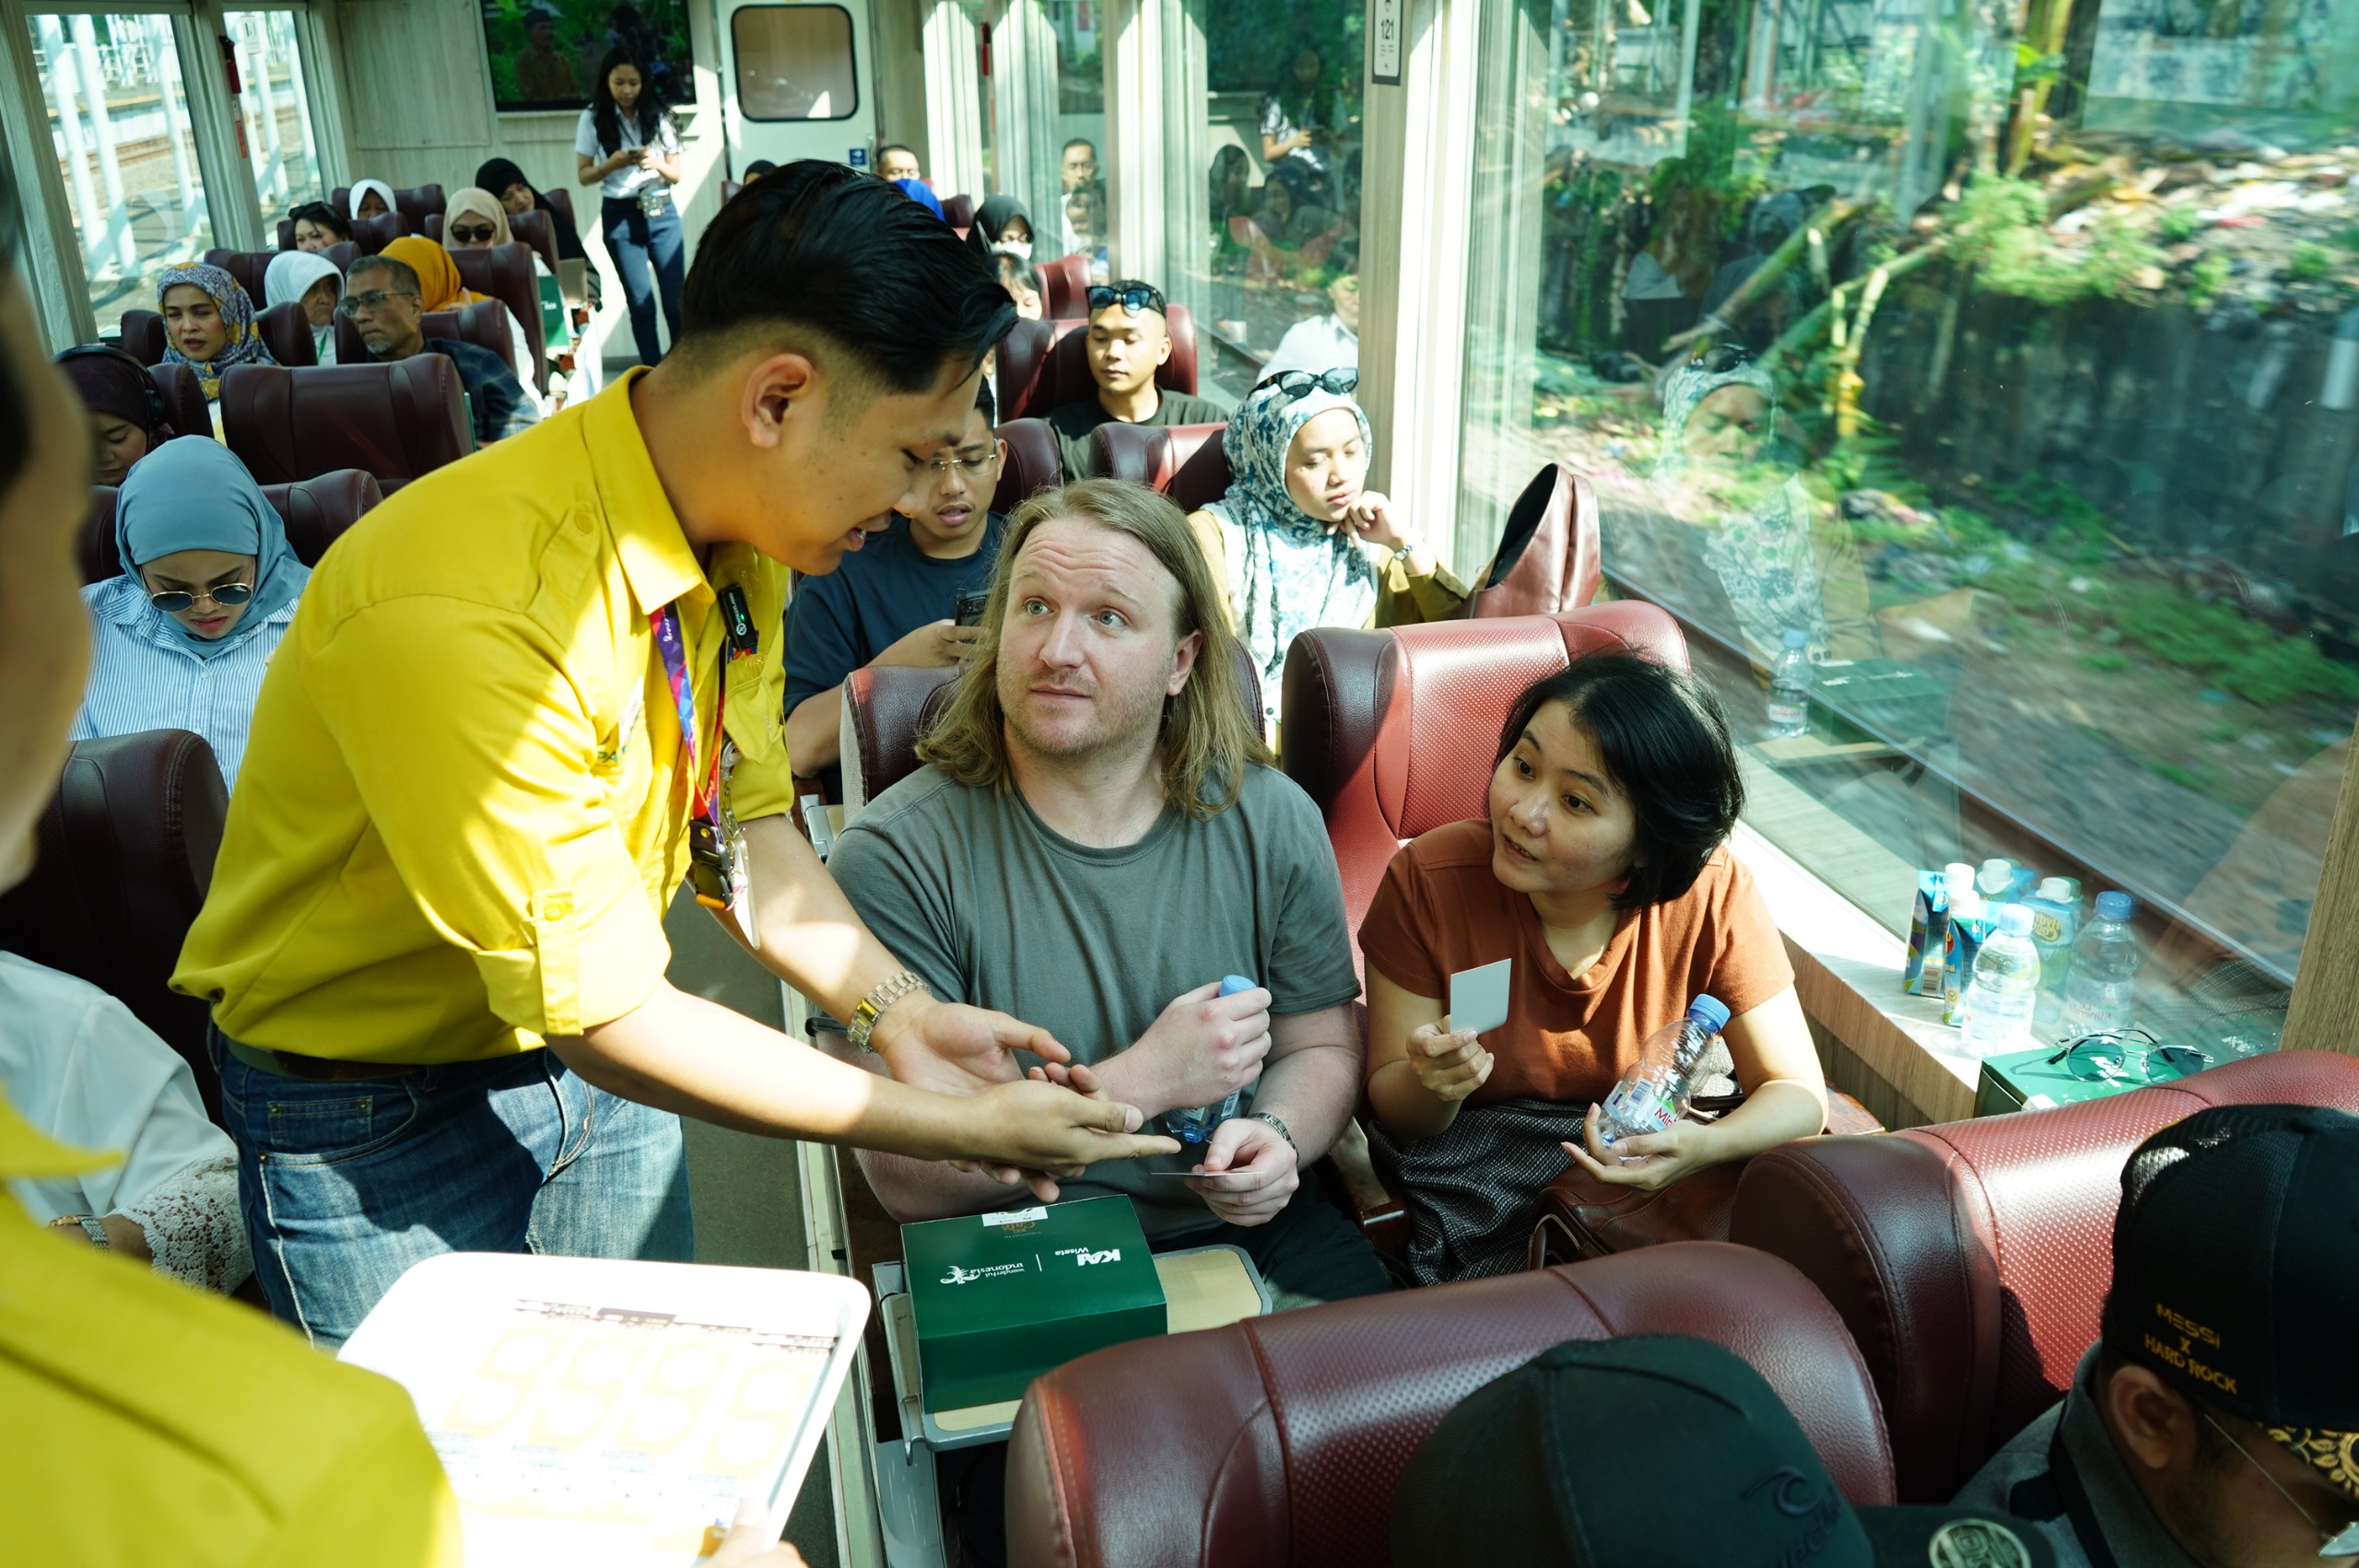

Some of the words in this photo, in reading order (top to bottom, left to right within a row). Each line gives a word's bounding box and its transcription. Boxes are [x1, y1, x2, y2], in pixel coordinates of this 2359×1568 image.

[1381, 18, 1394, 40] 121
[1055, 1247, 1089, 1256] Wisata
[1077, 1248, 1121, 1266] KAI
[969, 1262, 1024, 1275] indonesia
[985, 1268, 1025, 1278] wonderful
[2156, 1304, 2219, 1349] MESSI
[2144, 1334, 2186, 1368] HARD
[2189, 1359, 2237, 1395] ROCK
